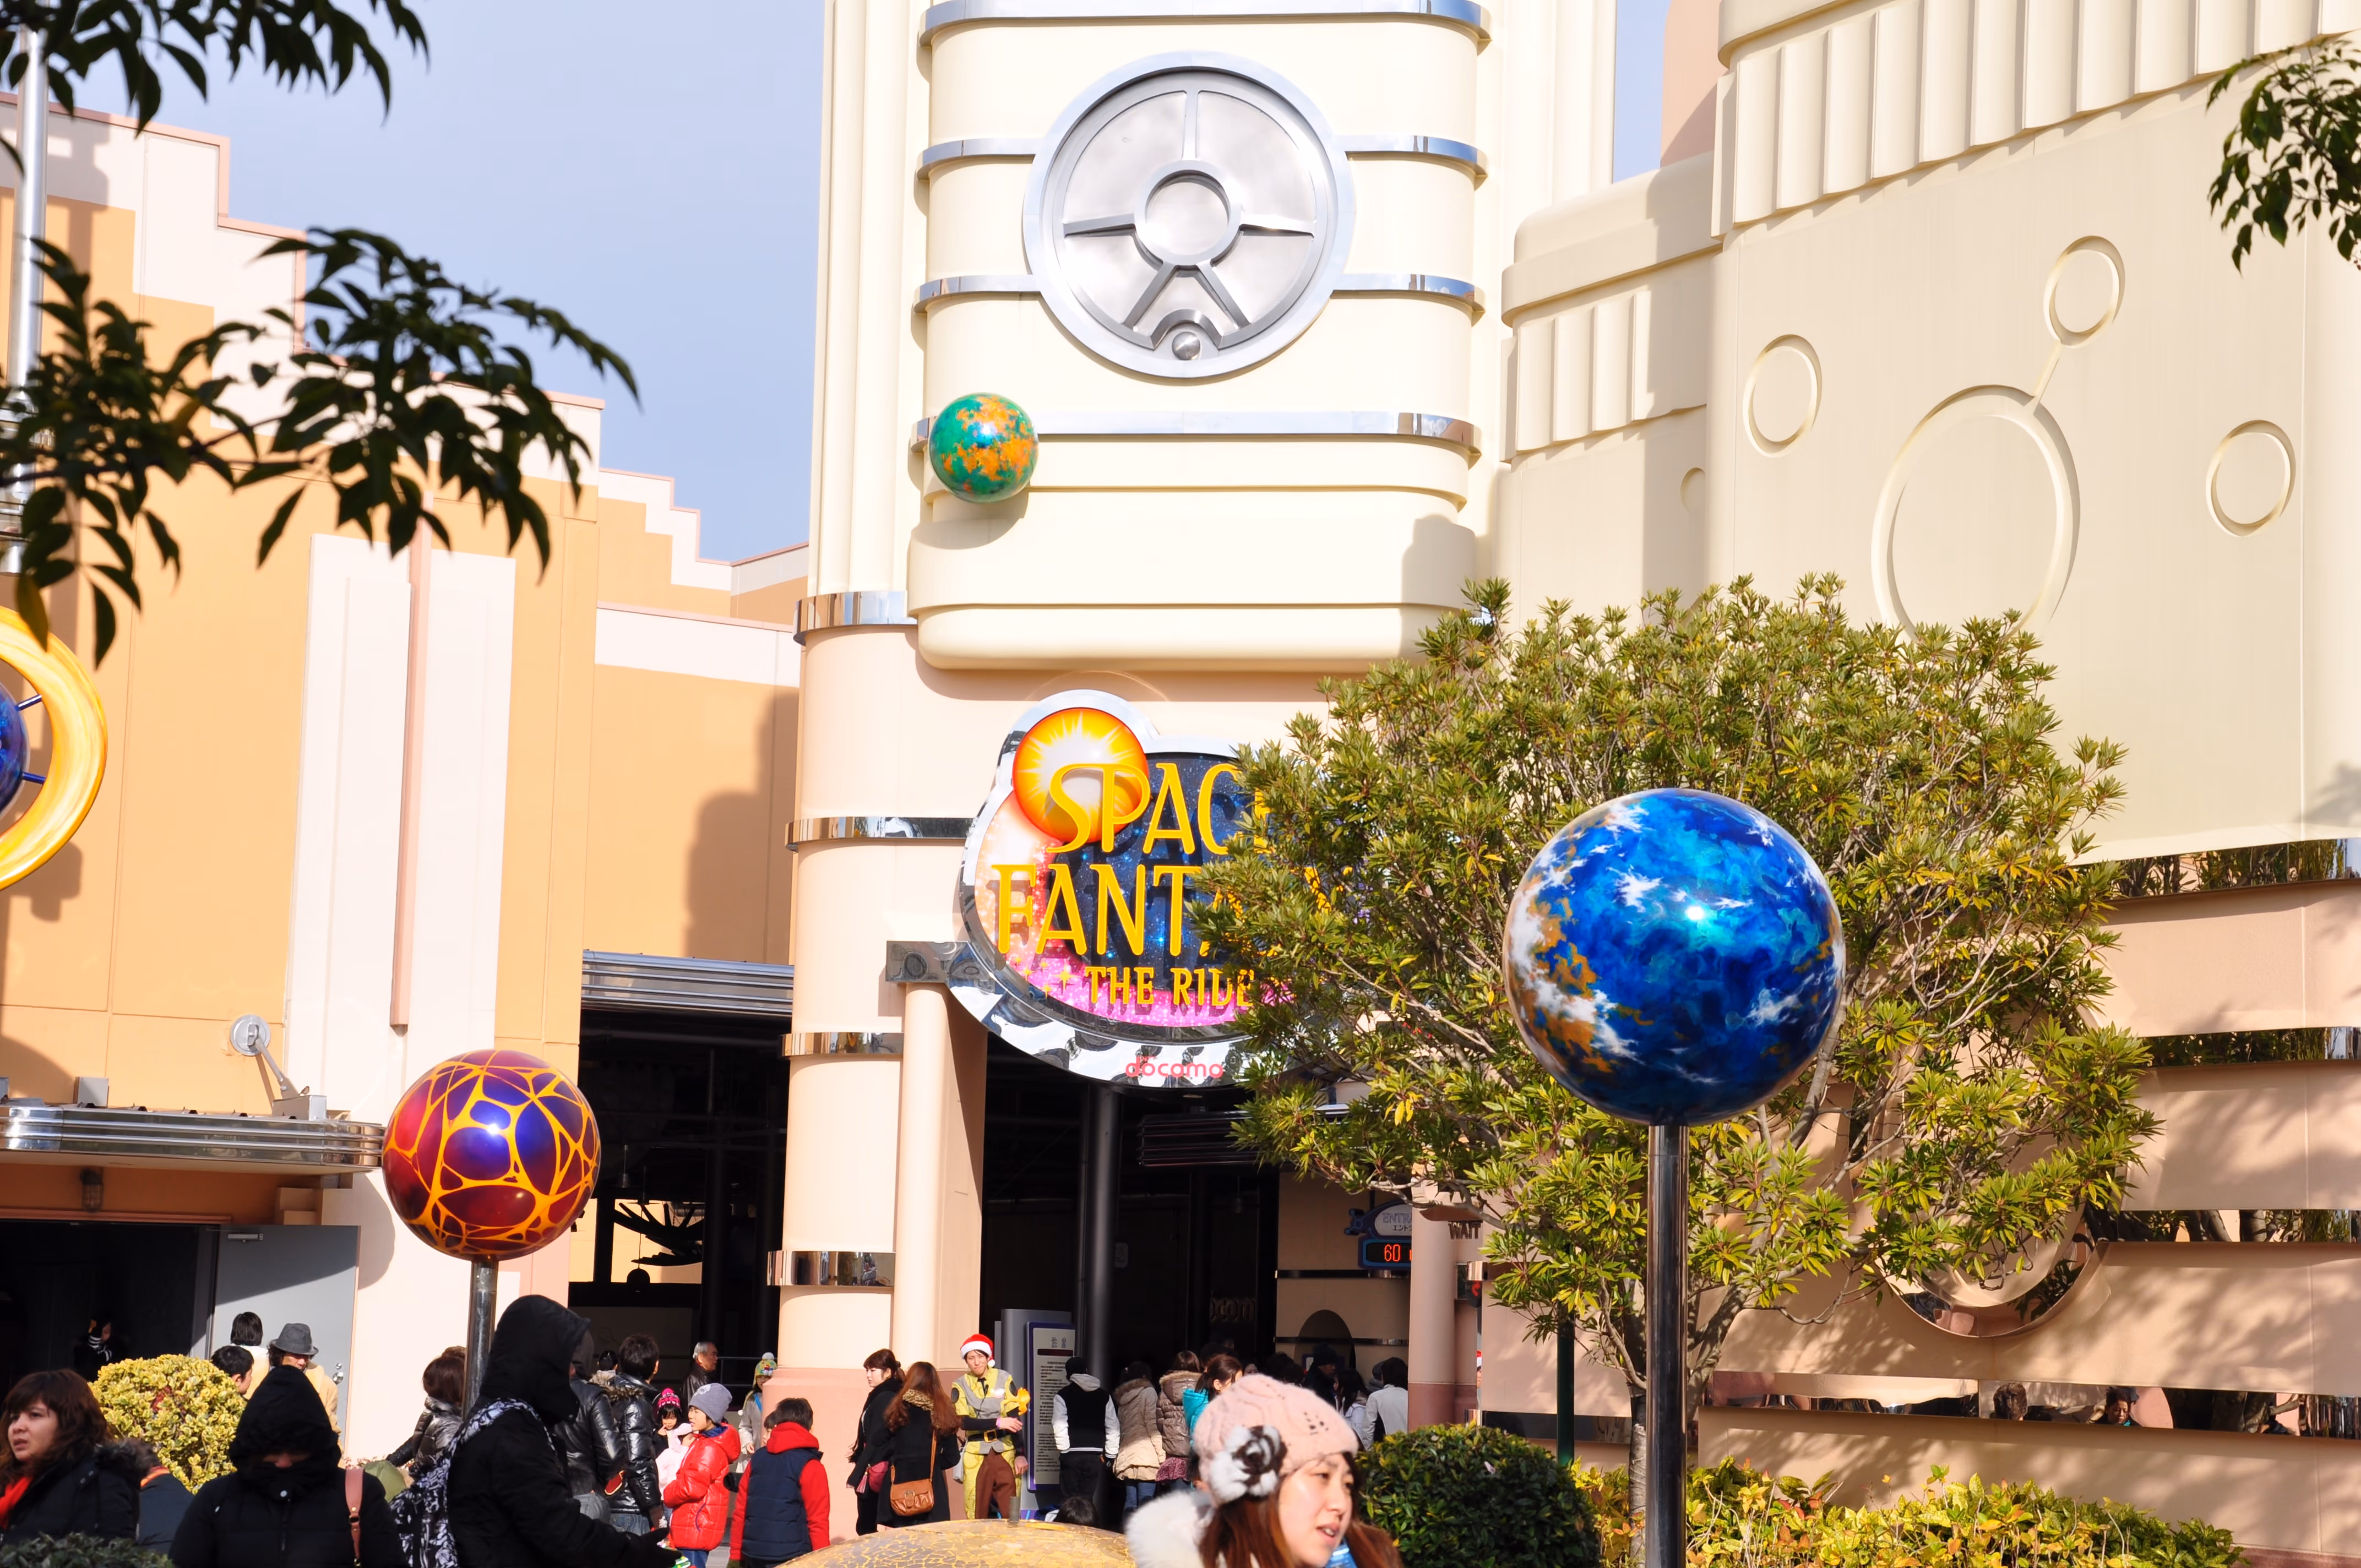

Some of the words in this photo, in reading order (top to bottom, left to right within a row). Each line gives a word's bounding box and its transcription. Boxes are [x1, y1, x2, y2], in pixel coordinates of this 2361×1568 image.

[1085, 966, 1154, 1004] THE
[1170, 968, 1254, 1006] RIDE
[1125, 1055, 1223, 1078] docomo
[1384, 1244, 1401, 1262] 60
